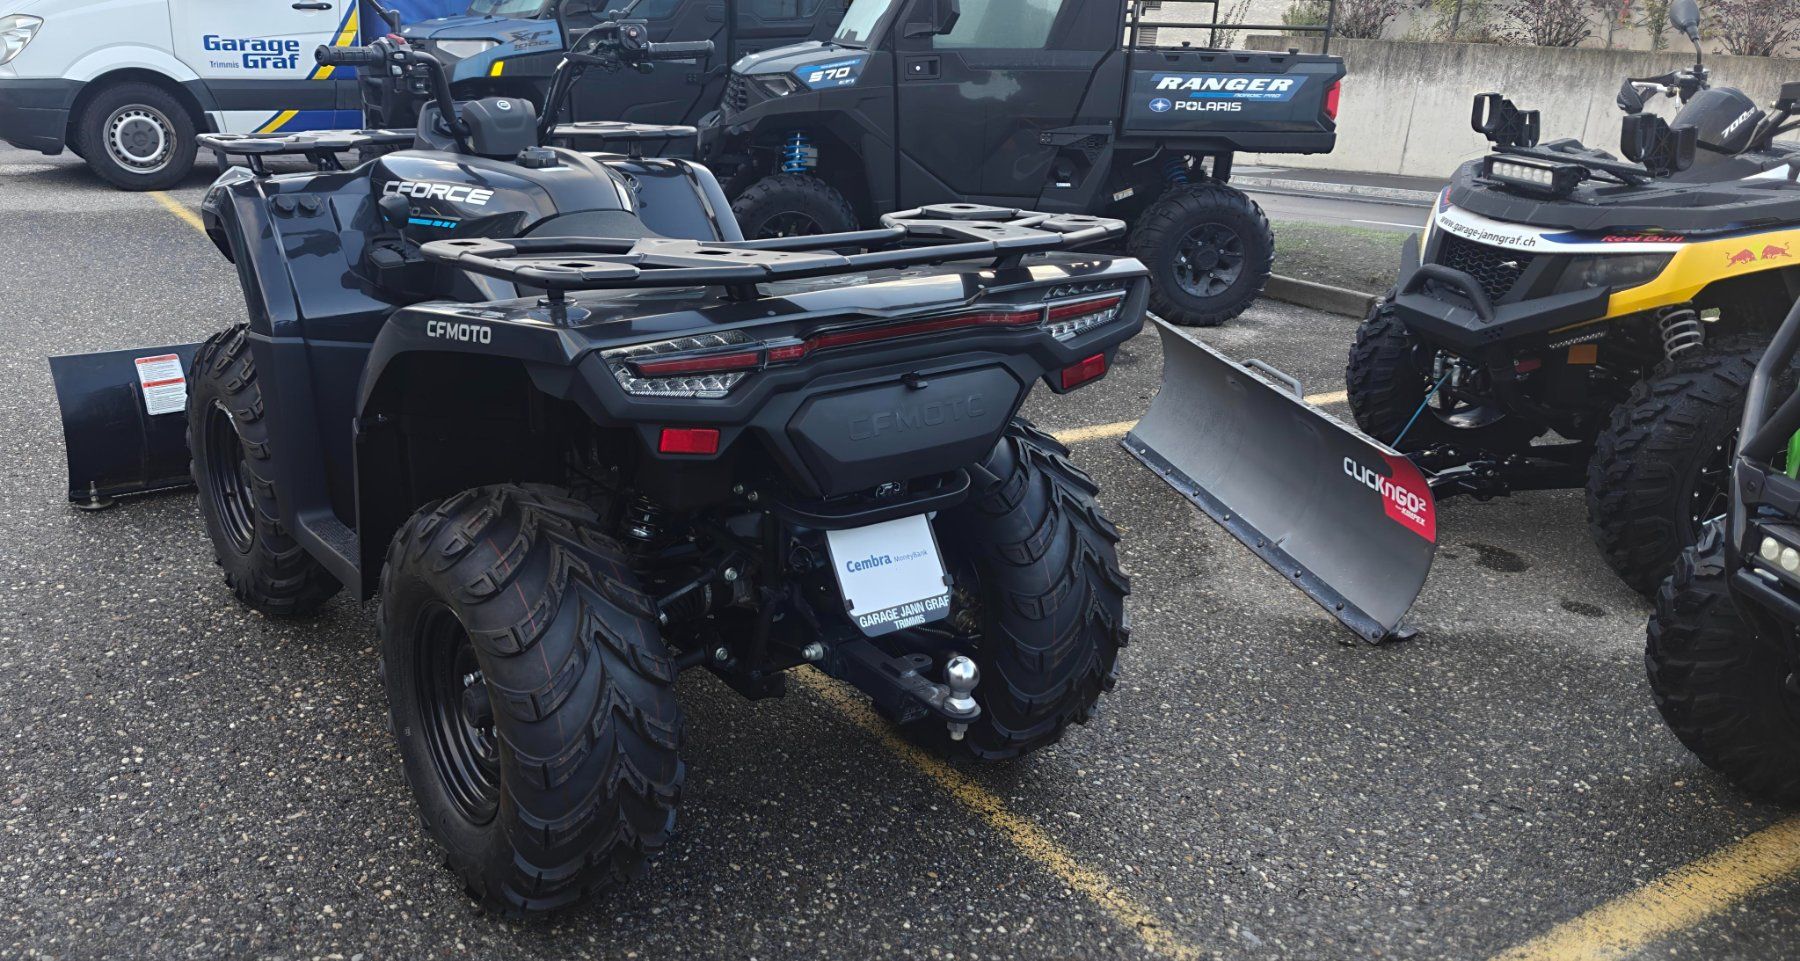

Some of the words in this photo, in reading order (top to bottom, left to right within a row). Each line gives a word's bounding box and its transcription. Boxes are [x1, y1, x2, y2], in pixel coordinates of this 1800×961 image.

[203, 35, 300, 56] Garage
[209, 60, 240, 68] Trimmis
[242, 53, 300, 69] Graf
[1156, 77, 1294, 92] RANGER
[1175, 101, 1242, 112] POLARIS
[1721, 110, 1749, 138] 700
[382, 181, 495, 206] CFORCE
[1440, 216, 1536, 247] www.garage-janngraf.ch
[1601, 234, 1642, 242] Red
[427, 320, 492, 344] CFMOTO
[846, 554, 892, 573] Cembra
[894, 549, 929, 563] MoneyBank
[859, 608, 900, 628] GARAGE
[900, 601, 926, 617] JANN
[924, 594, 950, 611] GRAF
[893, 614, 926, 630] TRIMMIS
